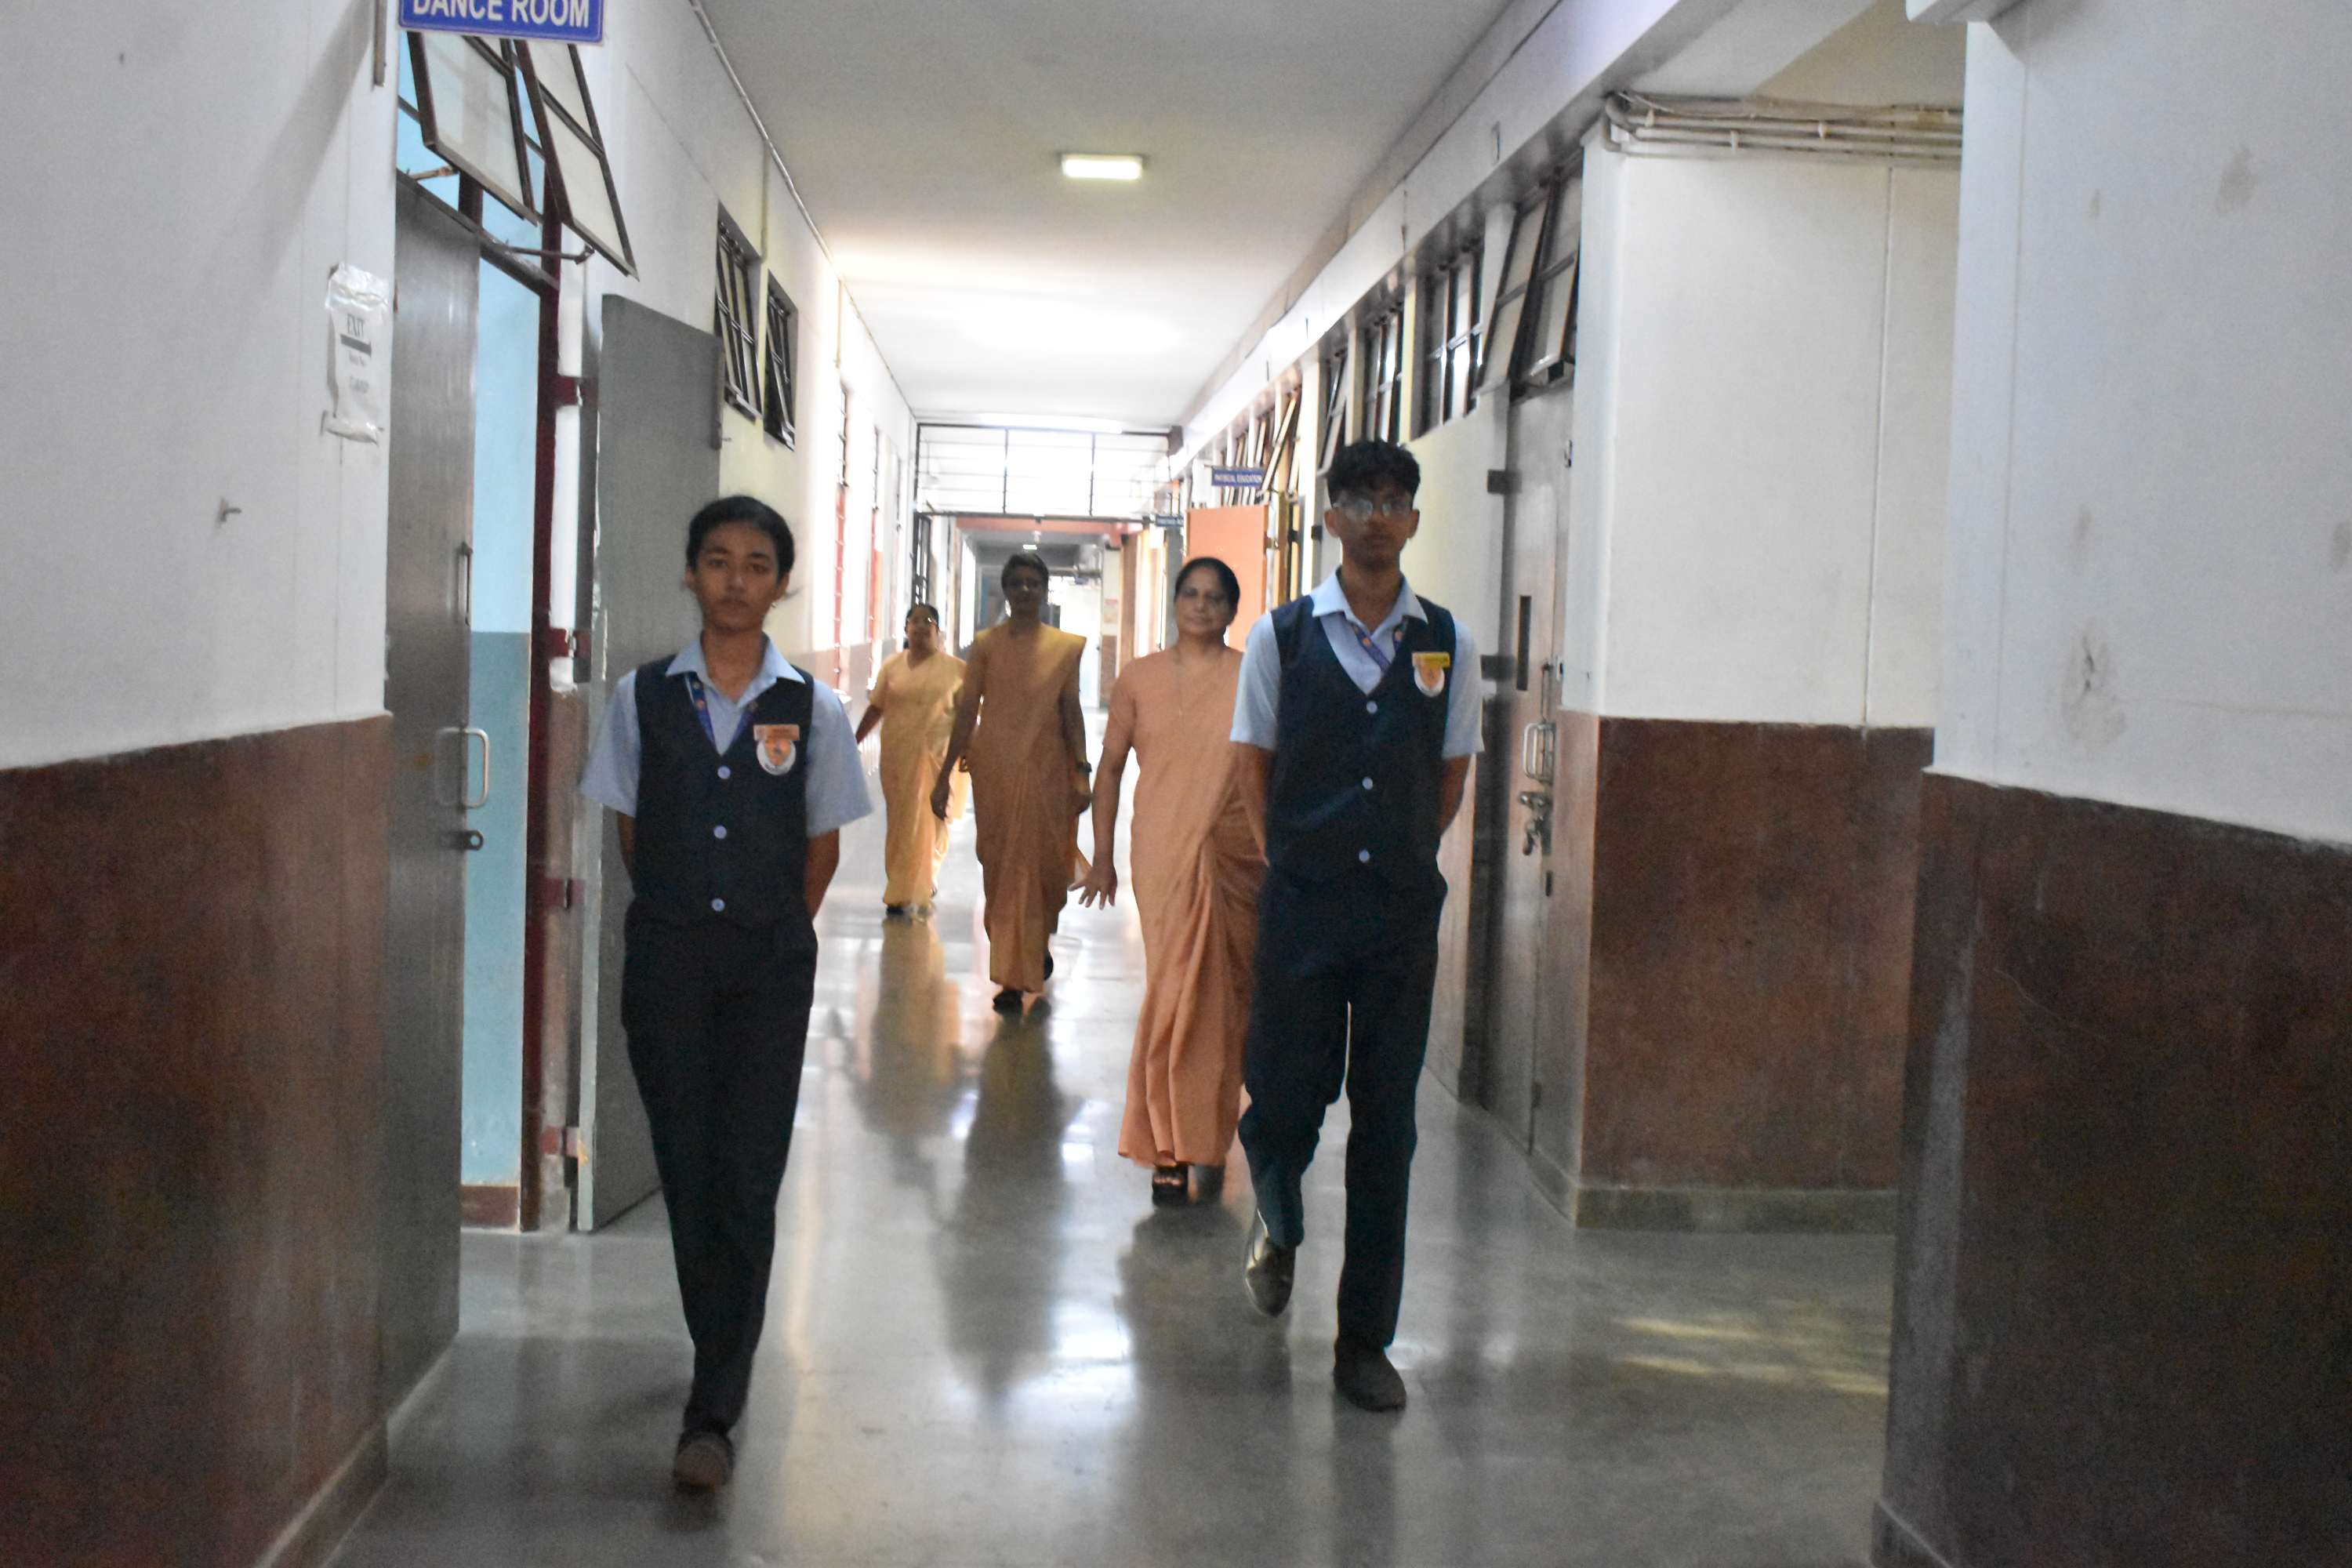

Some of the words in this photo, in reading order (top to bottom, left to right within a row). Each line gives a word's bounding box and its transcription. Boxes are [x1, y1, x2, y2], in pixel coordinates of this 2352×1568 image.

[412, 0, 503, 21] DANCE
[511, 0, 589, 28] ROOM
[346, 313, 365, 337] EXIT
